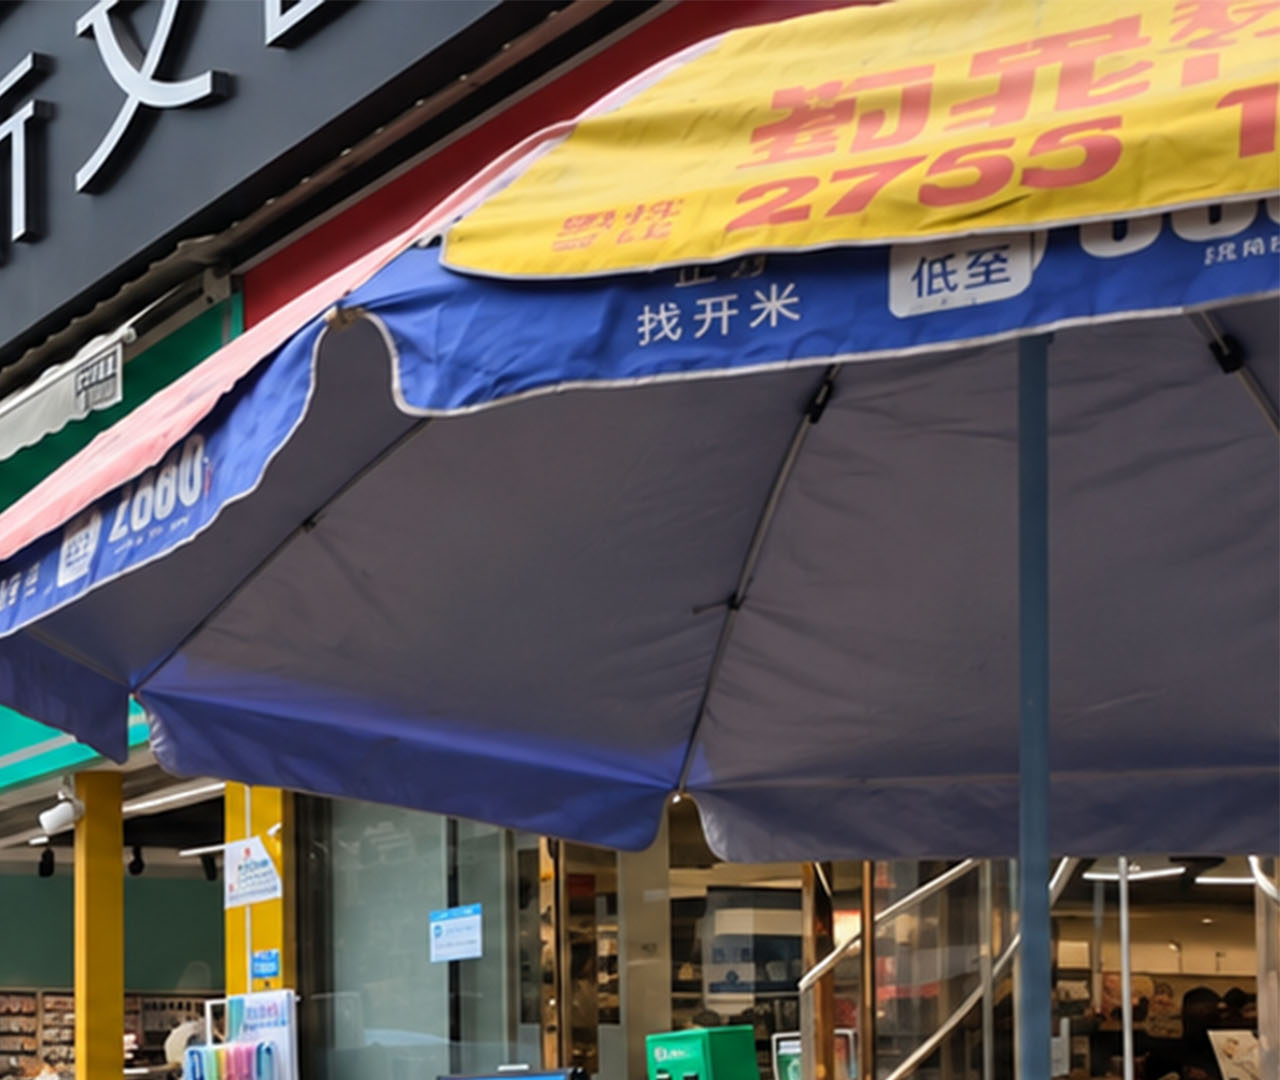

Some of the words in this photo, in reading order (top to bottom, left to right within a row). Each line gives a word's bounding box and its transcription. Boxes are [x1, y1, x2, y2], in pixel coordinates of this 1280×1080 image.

[724, 114, 1122, 235] 2755
[911, 245, 1011, 299] 低至
[638, 284, 801, 346] 找开米
